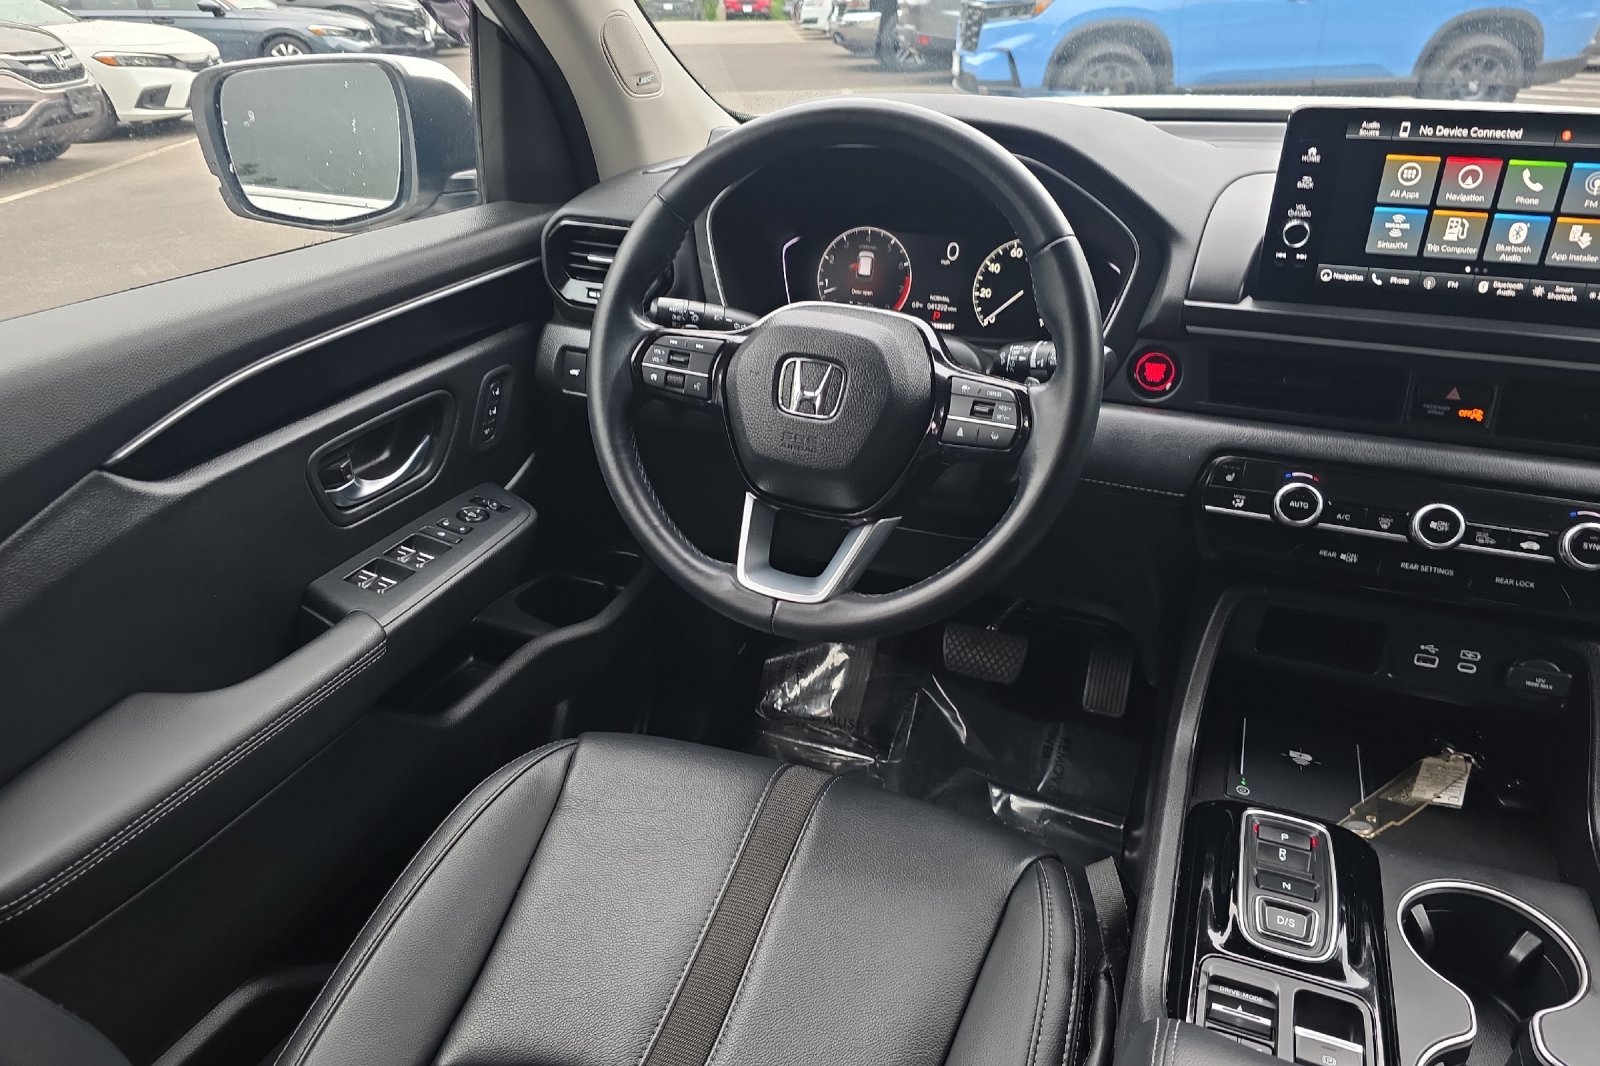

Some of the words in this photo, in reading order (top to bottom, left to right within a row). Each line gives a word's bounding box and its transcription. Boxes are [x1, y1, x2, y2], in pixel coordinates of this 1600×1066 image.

[1361, 120, 1380, 130] Audio
[1359, 128, 1380, 137] Source
[1419, 125, 1434, 136] No
[1435, 125, 1469, 138] Device
[1470, 127, 1524, 139] Connected
[1301, 154, 1321, 163] HOME
[1296, 180, 1314, 189] BACK
[1389, 189, 1401, 199] All
[1401, 190, 1420, 200] Apps
[1445, 191, 1485, 203] Navigation
[1515, 195, 1540, 206] Phone
[1583, 199, 1599, 209] FM
[946, 241, 960, 261] 0
[1376, 240, 1409, 251] SiriusXM
[1427, 243, 1441, 254] Trip
[1441, 244, 1478, 256] Computer
[1495, 243, 1532, 254] Bluetooth
[1009, 247, 1024, 259] 60
[1499, 253, 1522, 263] Audio
[1551, 251, 1568, 262] App
[1568, 253, 1599, 264] Installer
[987, 262, 1001, 274] 40
[1333, 272, 1364, 283] Navigation
[1389, 276, 1410, 286] Phone
[1447, 280, 1459, 289] FM
[1492, 280, 1524, 290] Bluetooth
[1554, 285, 1574, 294] Smart
[979, 287, 992, 299] 20
[1496, 289, 1516, 298] Audio
[1547, 292, 1578, 303] Shortcuts
[1289, 500, 1309, 510] AUTO
[1336, 512, 1351, 521] A/C
[1582, 541, 1600, 551] SYN
[1319, 549, 1337, 559] REAR
[1400, 561, 1419, 571] REAR
[1420, 564, 1454, 577] SETTINGS
[1495, 576, 1514, 586] REAR
[1515, 579, 1535, 589] LOCK
[1281, 833, 1289, 842] P
[1282, 881, 1292, 890] N
[1276, 914, 1296, 928] D/S
[1218, 985, 1242, 997] DRIVE
[1242, 991, 1264, 1003] MODE
